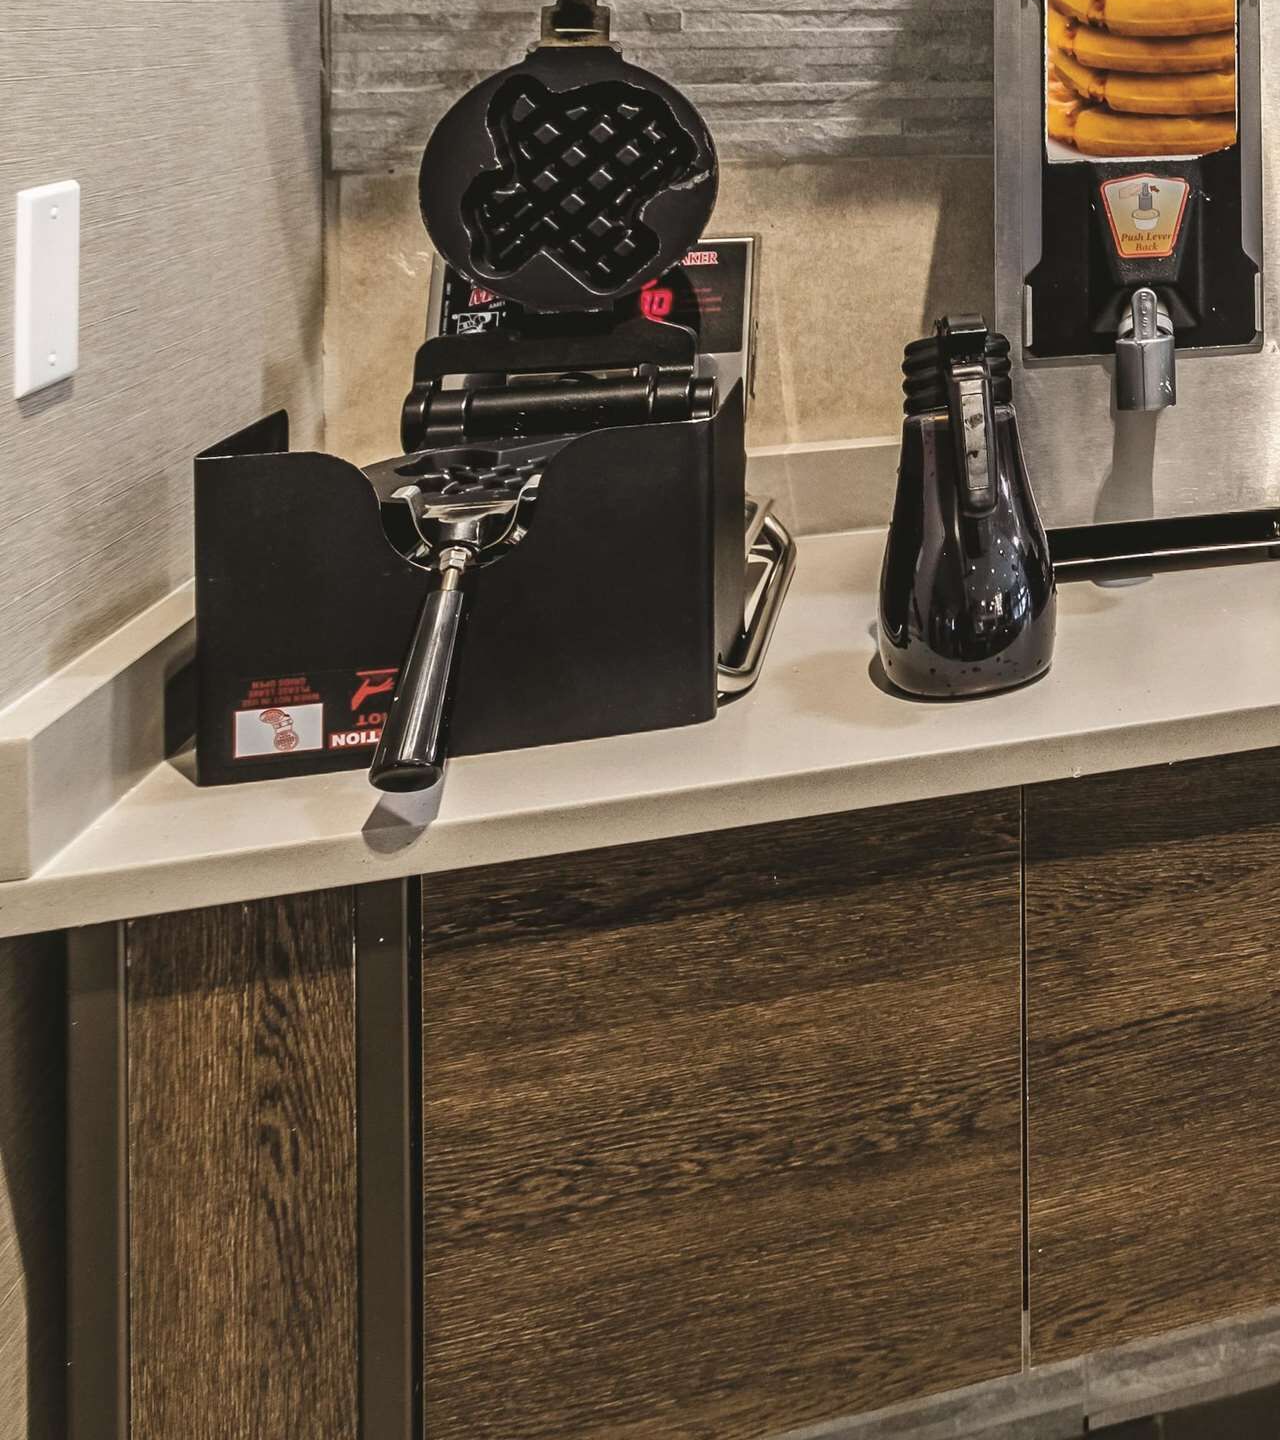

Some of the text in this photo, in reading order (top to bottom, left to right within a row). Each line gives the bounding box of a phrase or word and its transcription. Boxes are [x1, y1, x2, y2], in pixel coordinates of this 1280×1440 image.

[1121, 231, 1172, 242] Push Lever
[1135, 242, 1159, 252] Back
[332, 729, 382, 748] TION
